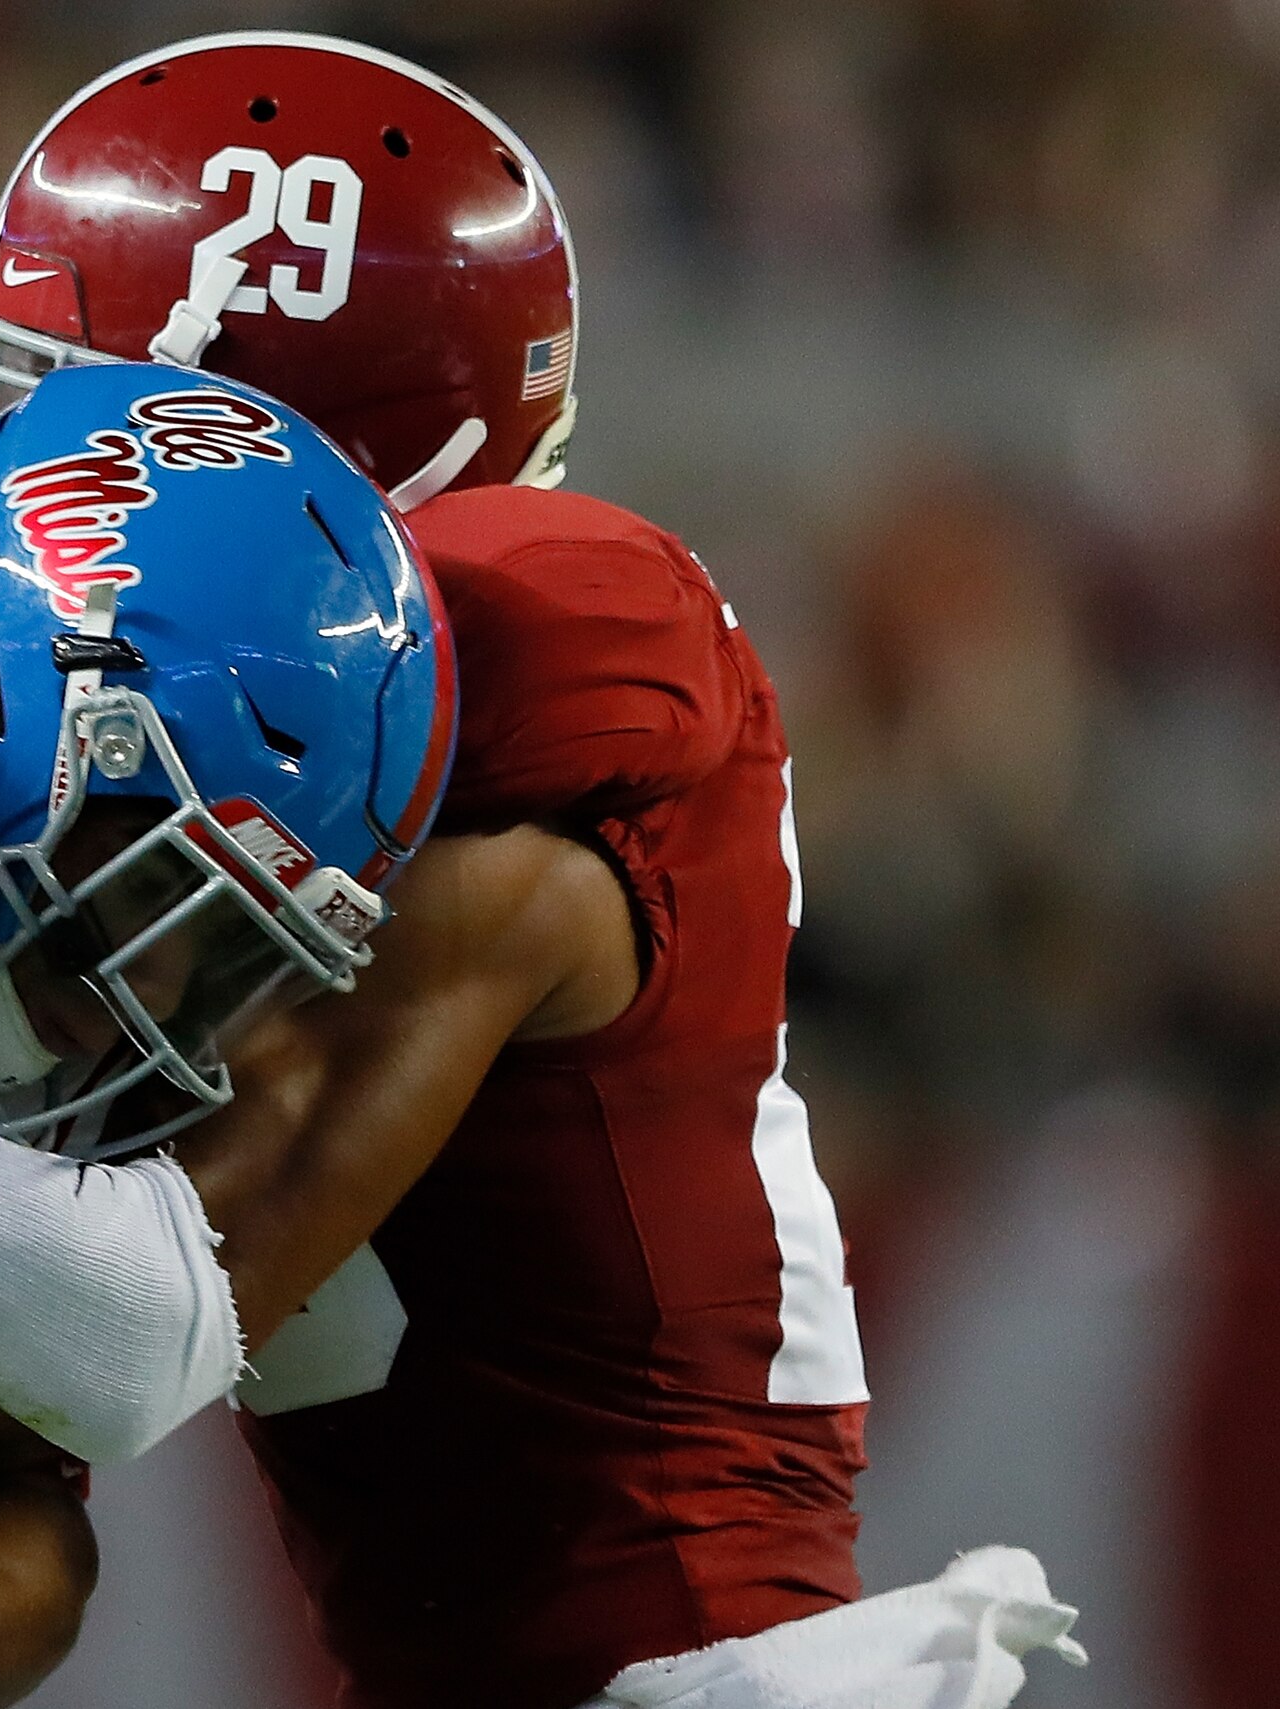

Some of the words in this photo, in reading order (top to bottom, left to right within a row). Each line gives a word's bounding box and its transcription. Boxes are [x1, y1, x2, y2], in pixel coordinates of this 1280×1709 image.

[189, 146, 363, 321] 29
[129, 389, 293, 471] Ole
[0, 429, 159, 622] Miss
